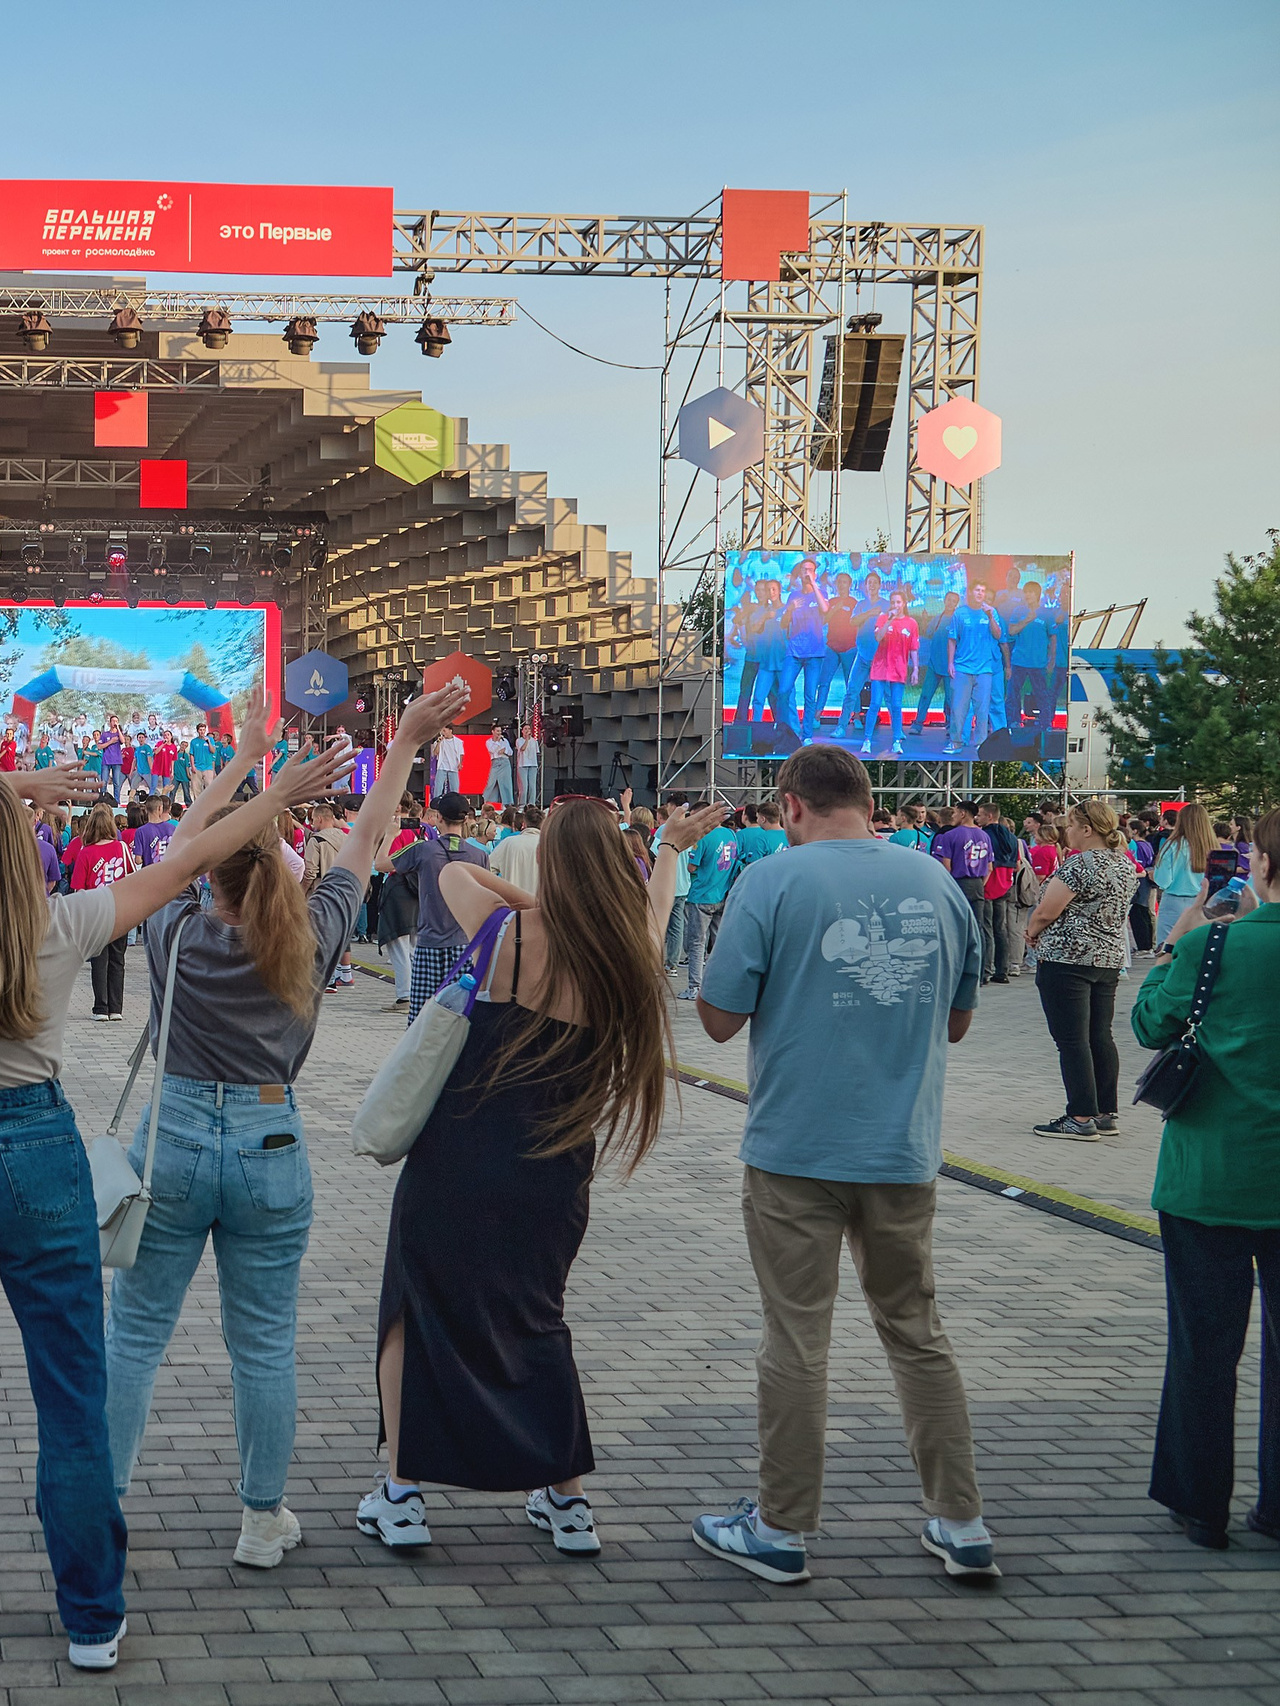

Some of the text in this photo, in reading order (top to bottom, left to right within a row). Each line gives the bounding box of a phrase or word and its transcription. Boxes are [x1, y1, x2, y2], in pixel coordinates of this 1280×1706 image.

[45, 209, 156, 225] БОЛЬШАЯ
[42, 225, 152, 241] ПЕРЕМЕНА
[219, 222, 332, 245] это Первые
[42, 247, 156, 258] проект от росмолодёжь
[159, 840, 167, 855] 5
[724, 845, 731, 861] 5
[971, 845, 981, 859] 5
[104, 863, 115, 883] 5
